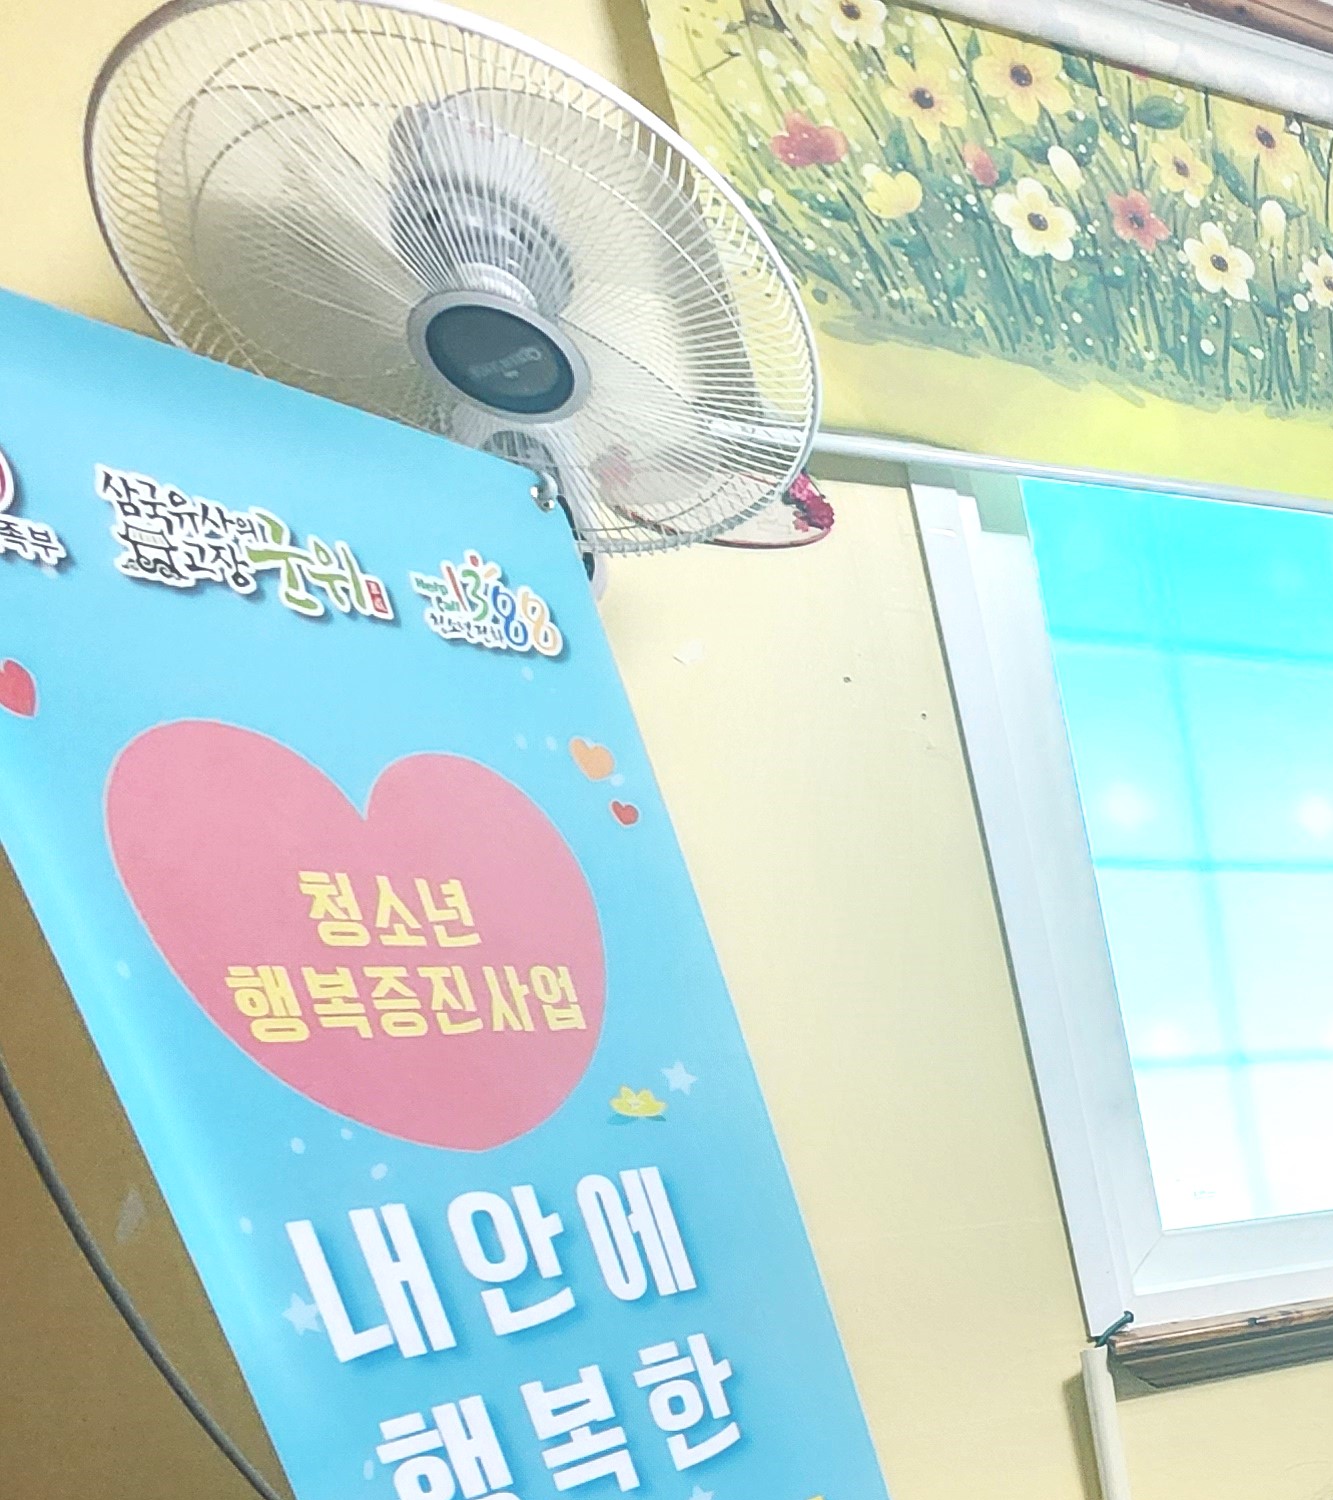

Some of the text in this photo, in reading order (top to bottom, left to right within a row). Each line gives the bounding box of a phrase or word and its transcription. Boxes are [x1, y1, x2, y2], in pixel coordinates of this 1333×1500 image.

[102, 470, 257, 543] 삼국유사의
[182, 540, 250, 588] 고장
[446, 566, 558, 651] 1388
[298, 870, 482, 948] 청소년
[224, 964, 588, 1043] 행복증진사업
